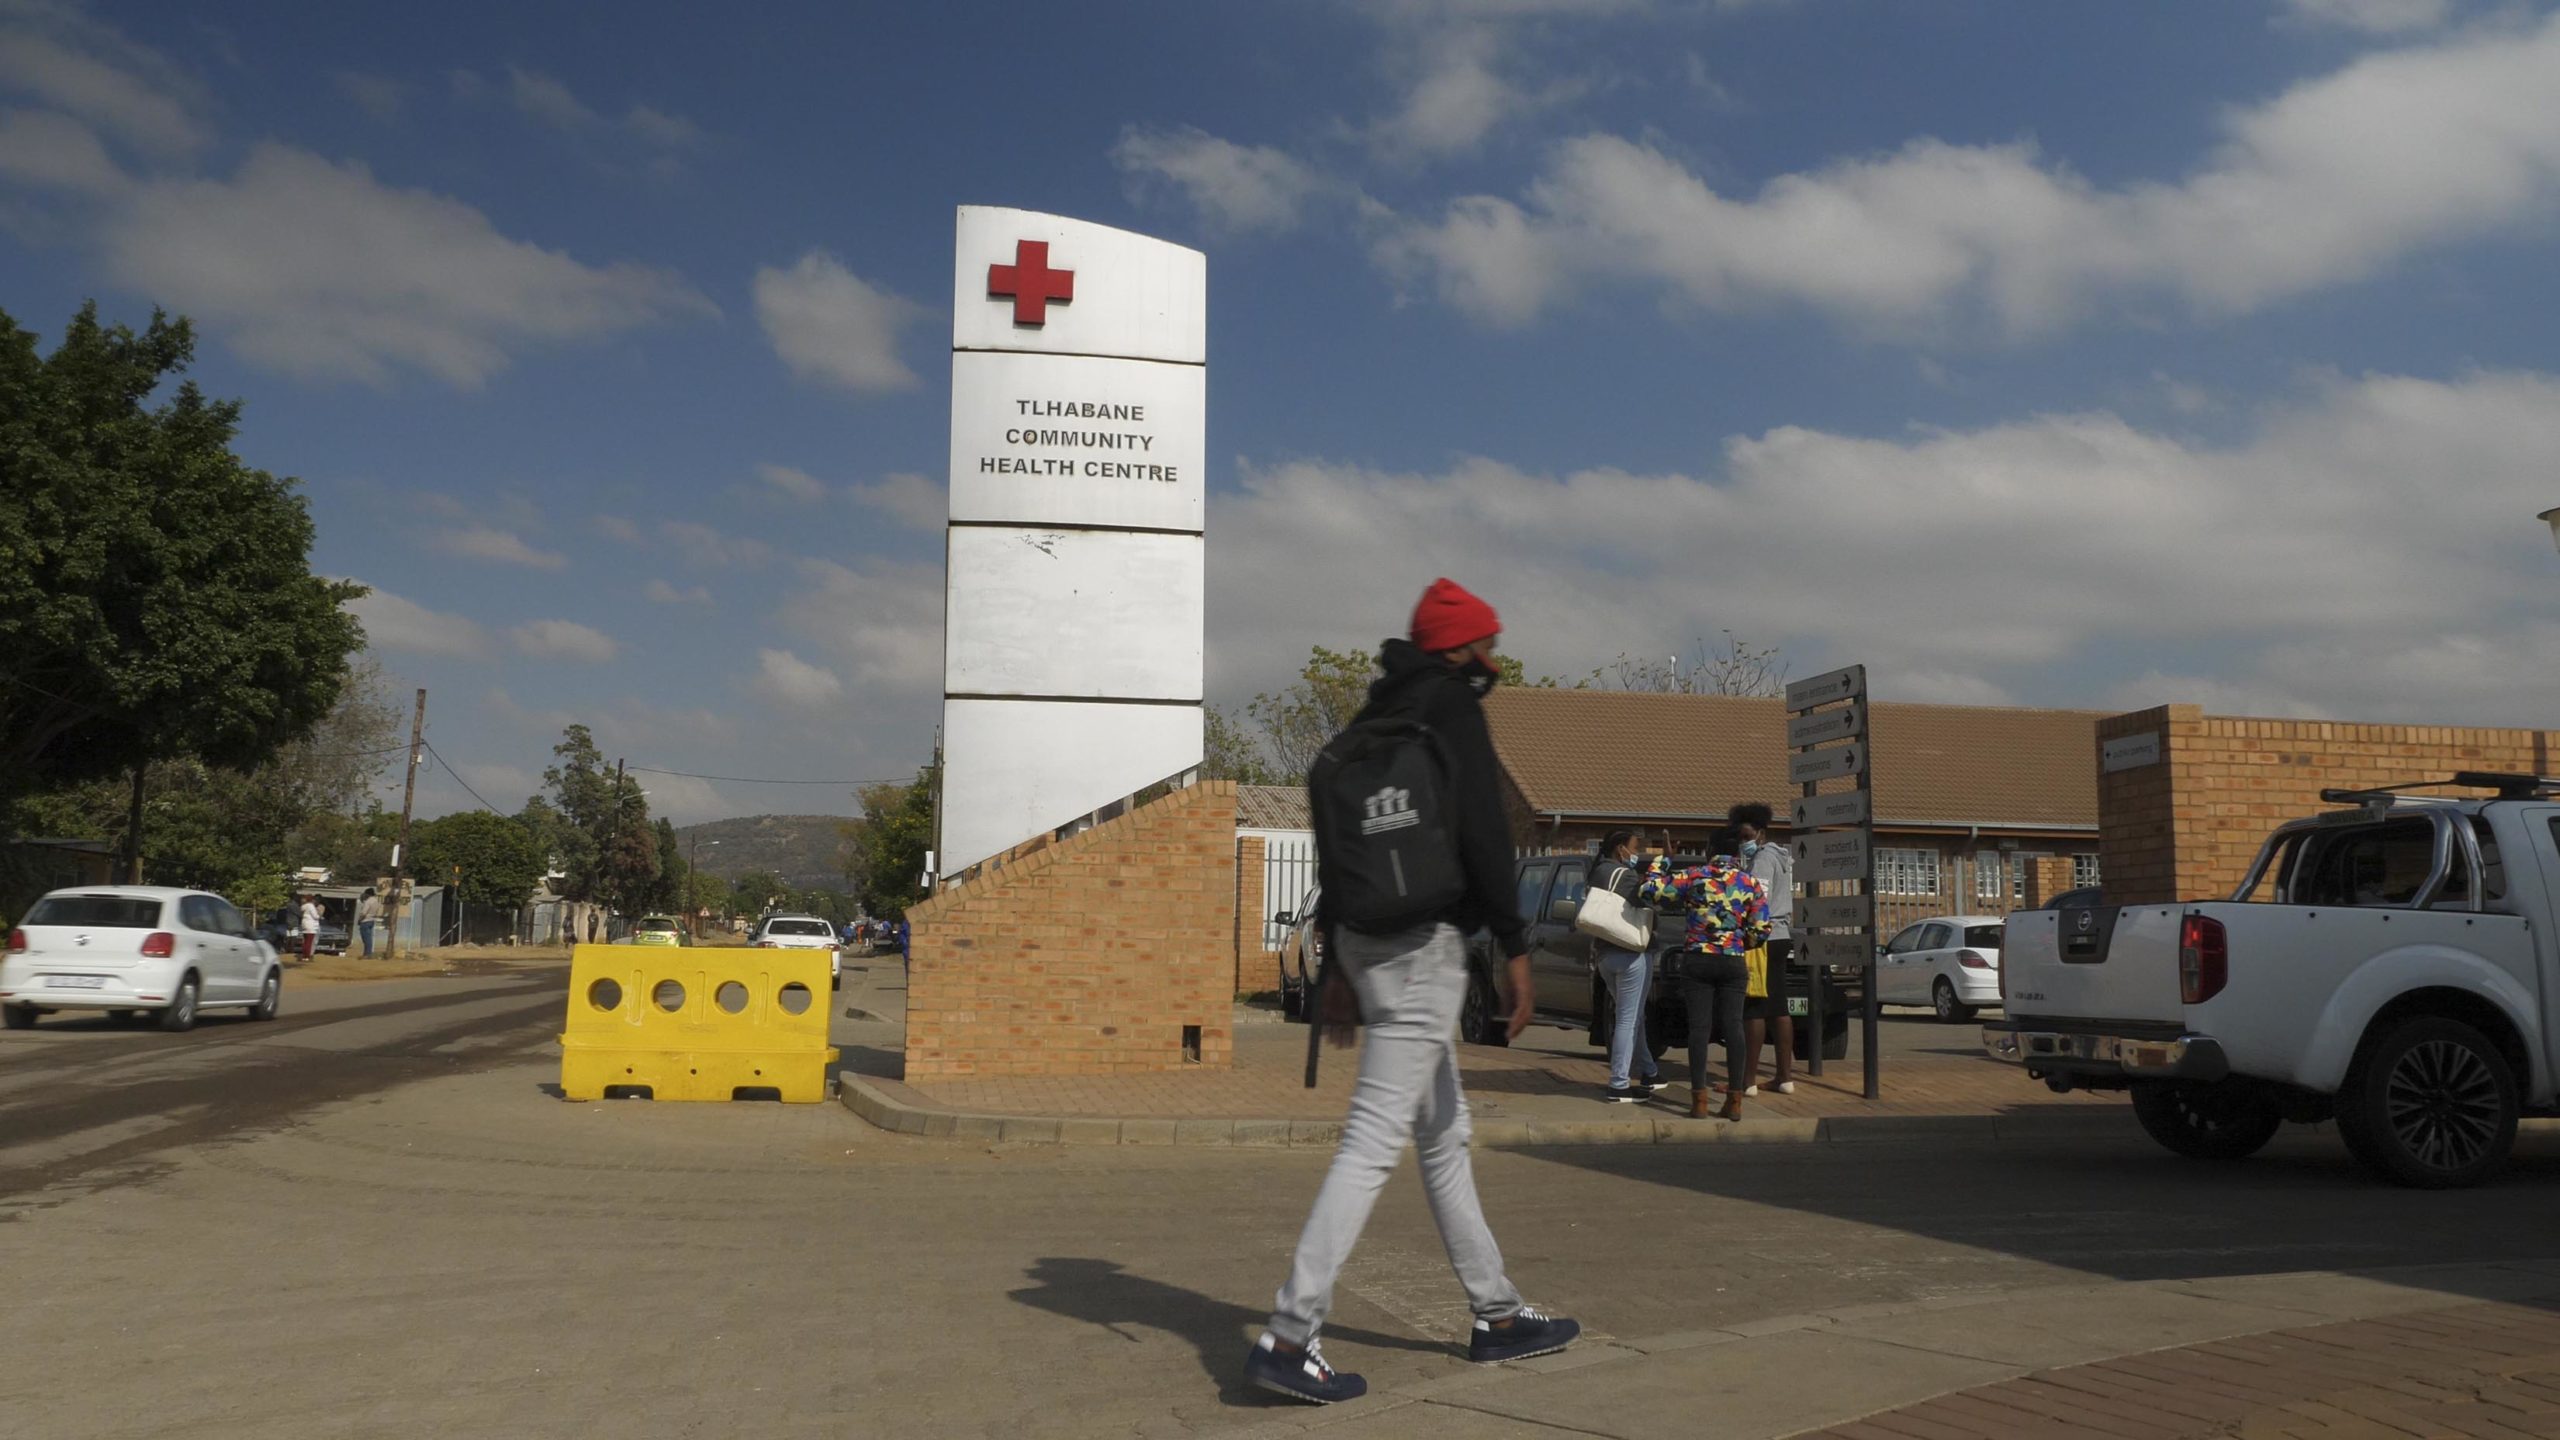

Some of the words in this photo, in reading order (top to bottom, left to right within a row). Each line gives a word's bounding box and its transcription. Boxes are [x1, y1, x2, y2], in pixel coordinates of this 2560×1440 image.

[1016, 399, 1145, 421] TLHABANE
[1005, 428, 1154, 451] COMMUNITY
[980, 457, 1075, 476] HEALTH
[1084, 461, 1178, 483] CENTRE
